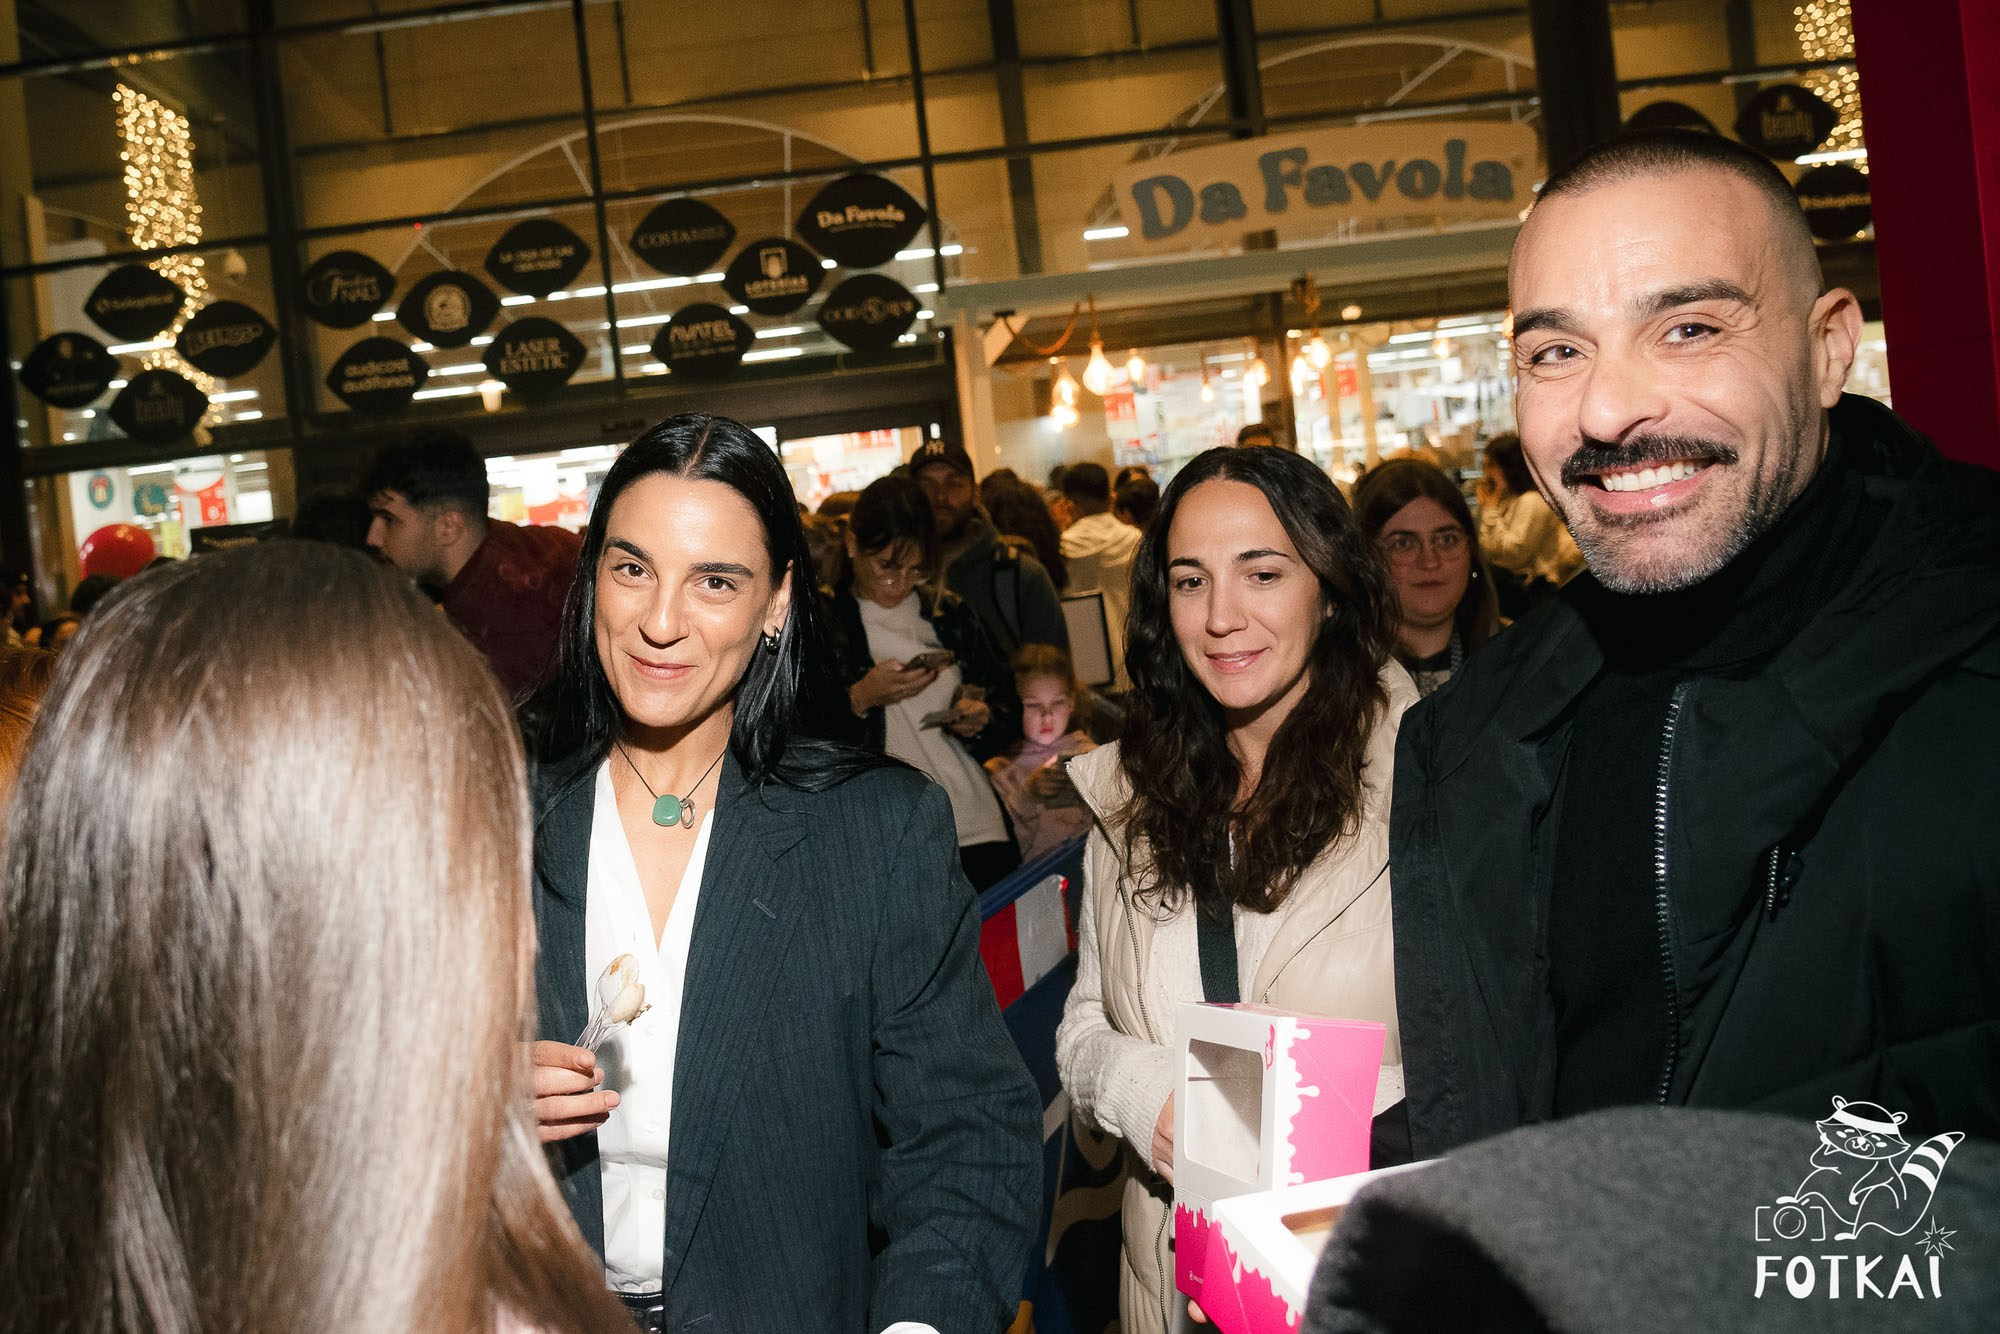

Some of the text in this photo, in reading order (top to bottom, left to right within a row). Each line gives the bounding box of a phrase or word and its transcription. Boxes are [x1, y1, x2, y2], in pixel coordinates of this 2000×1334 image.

[1132, 138, 1515, 241] Da Favola
[816, 210, 845, 229] Da
[845, 204, 906, 223] Favola
[669, 320, 737, 343] AVATEL
[505, 337, 561, 358] LASER
[500, 352, 569, 374] ESTETIC
